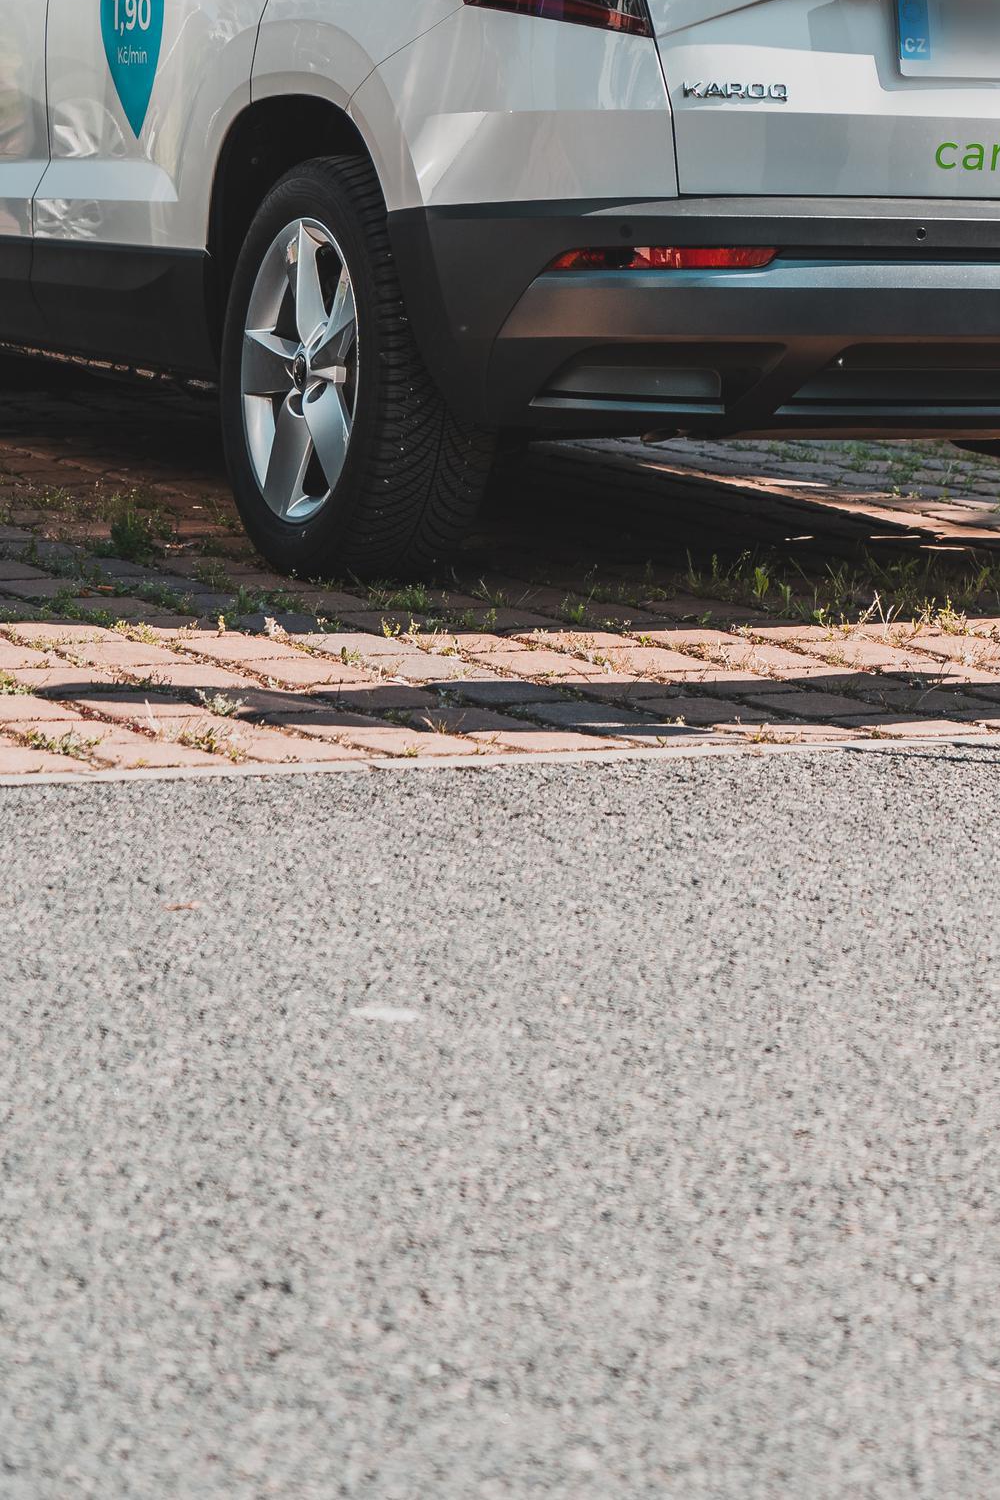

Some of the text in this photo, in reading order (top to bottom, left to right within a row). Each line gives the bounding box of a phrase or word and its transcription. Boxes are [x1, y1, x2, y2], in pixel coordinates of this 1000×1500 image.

[117, 45, 148, 66] Kč/min
[904, 37, 927, 54] CZ
[682, 80, 789, 102] KAROQ
